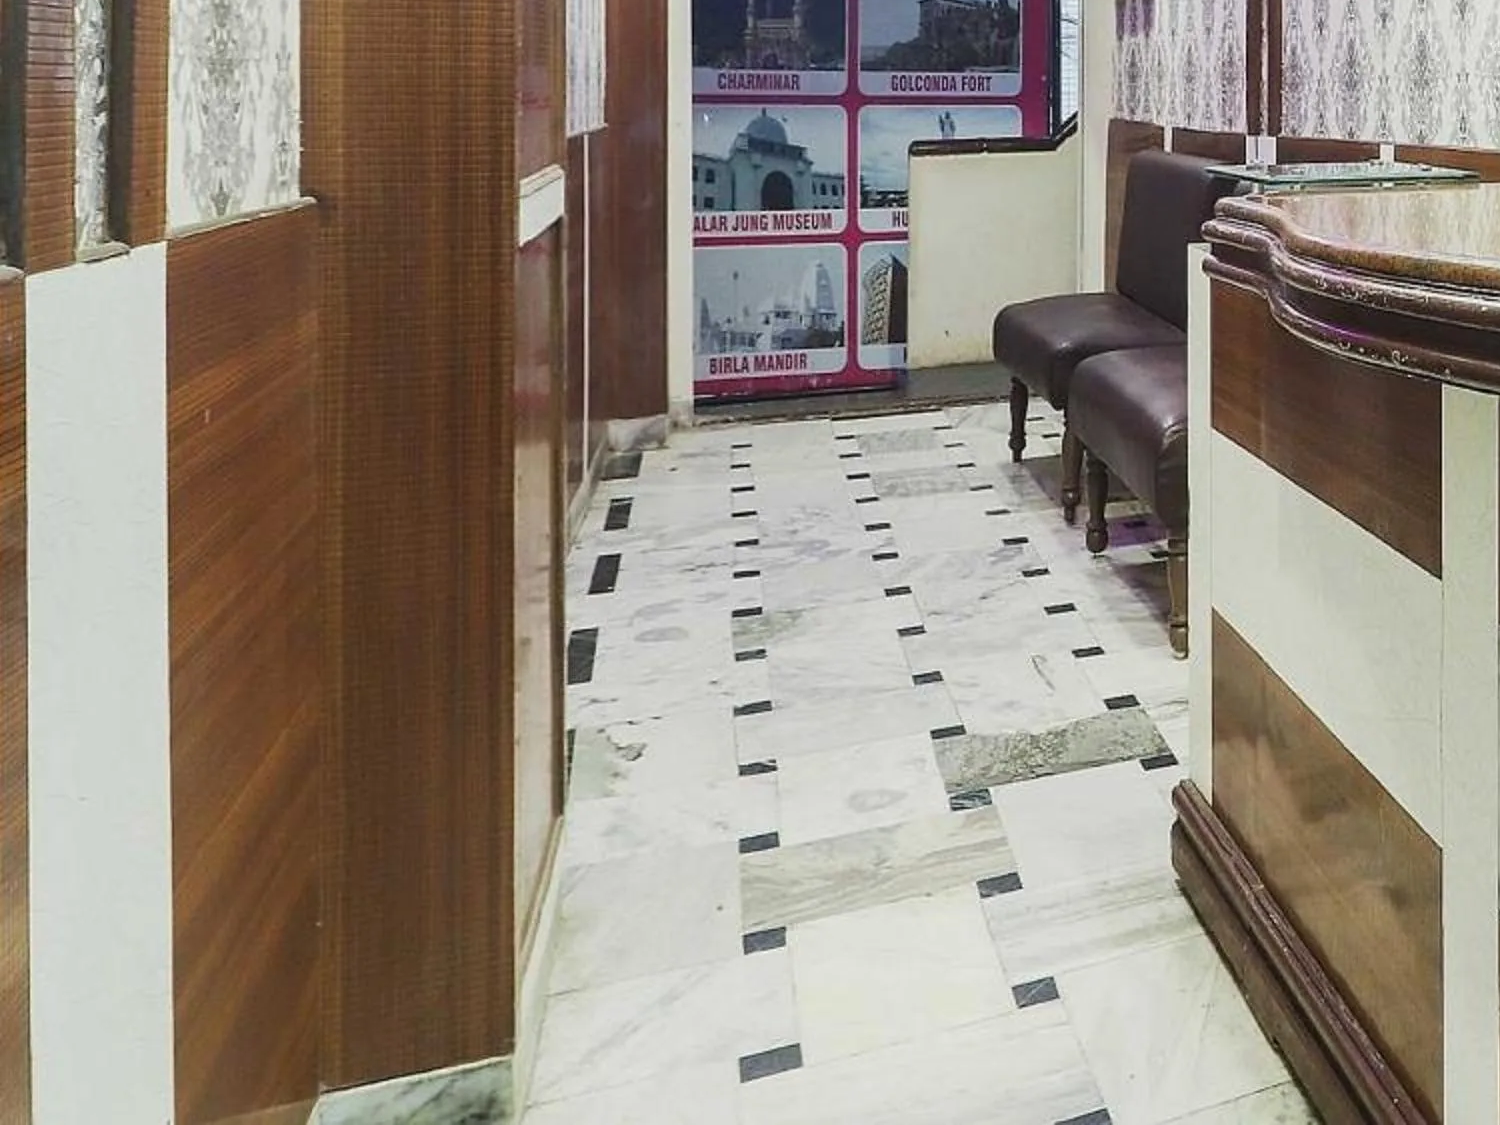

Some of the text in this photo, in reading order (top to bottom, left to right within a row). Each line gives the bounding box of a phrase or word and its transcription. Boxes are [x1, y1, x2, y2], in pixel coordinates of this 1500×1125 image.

[717, 73, 801, 91] CHARMINAR
[891, 75, 993, 92] GOLCONDA FORT
[731, 214, 769, 231] JUNG
[773, 212, 833, 230] MUSEUM
[709, 353, 808, 374] BIRLA MANDIR
